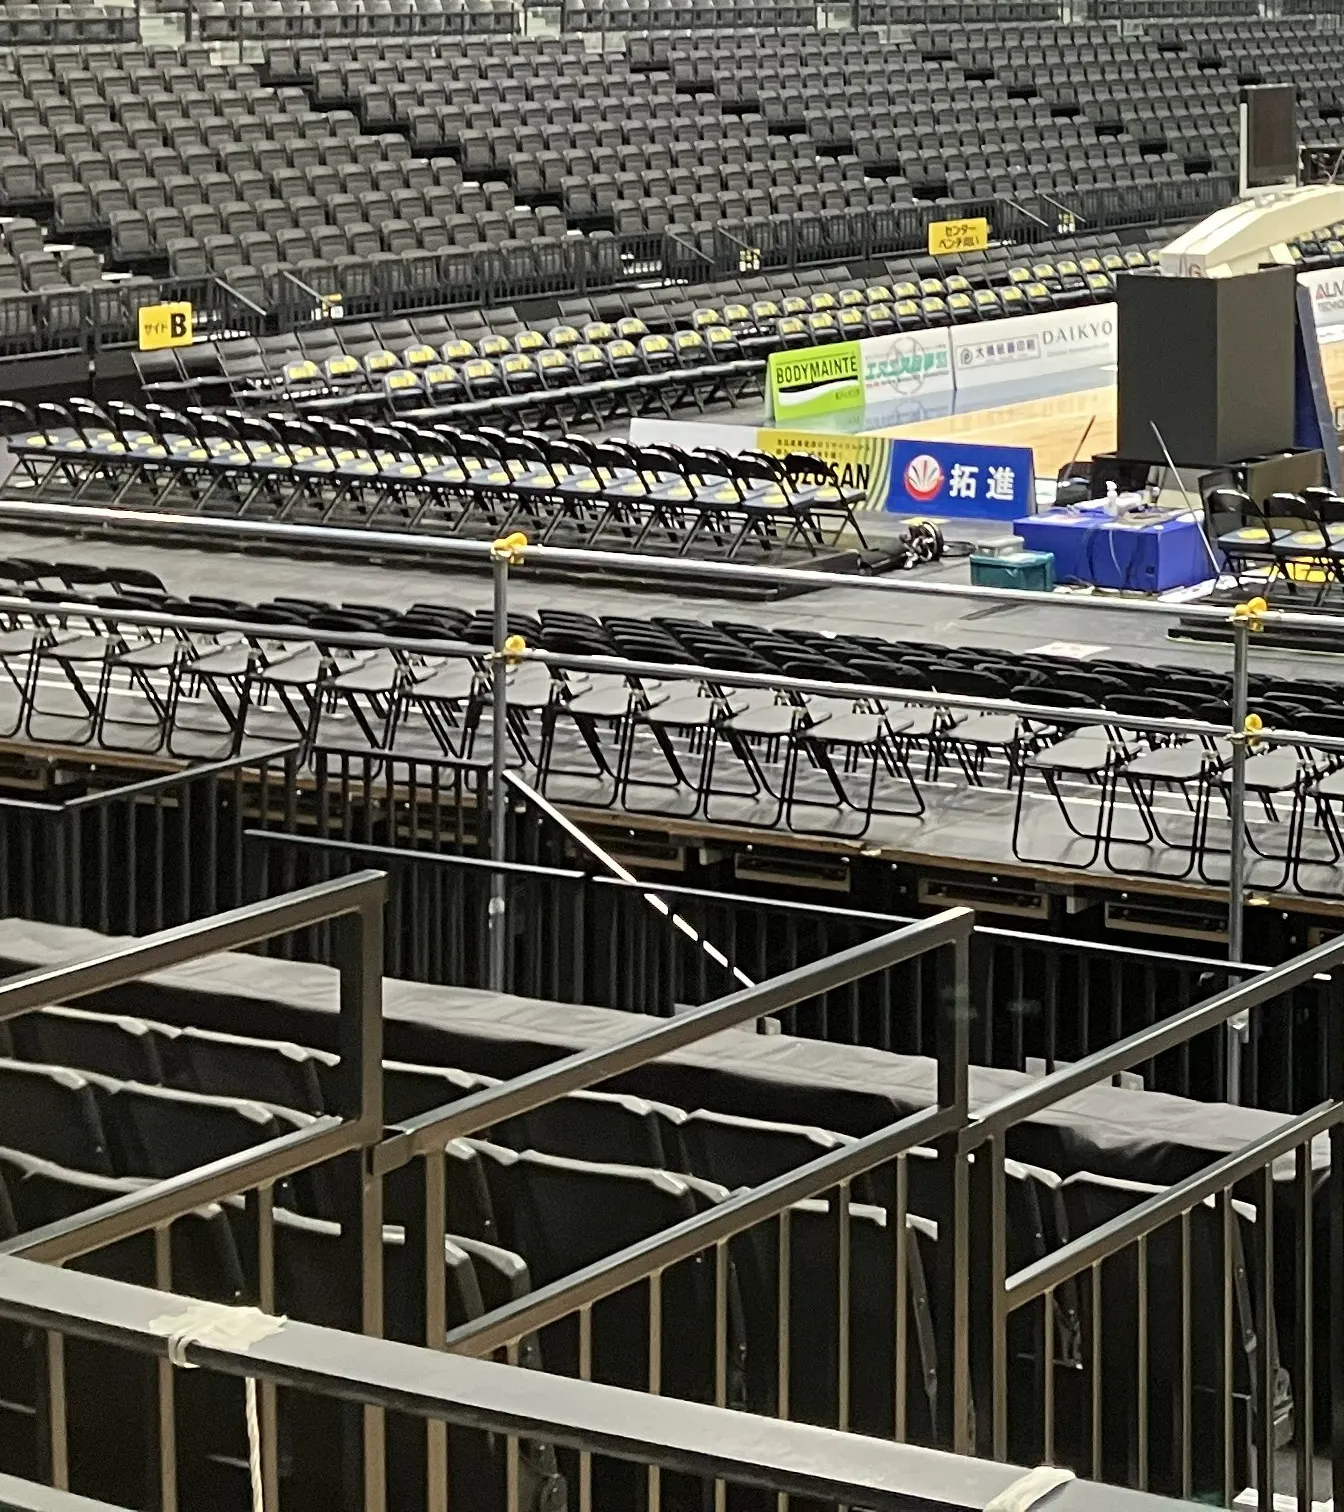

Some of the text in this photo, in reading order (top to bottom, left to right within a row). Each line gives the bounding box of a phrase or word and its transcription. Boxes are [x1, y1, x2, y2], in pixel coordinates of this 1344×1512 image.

[169, 312, 188, 339] B
[1042, 320, 1113, 345] DAIKYO
[948, 463, 1016, 501] 拓進
